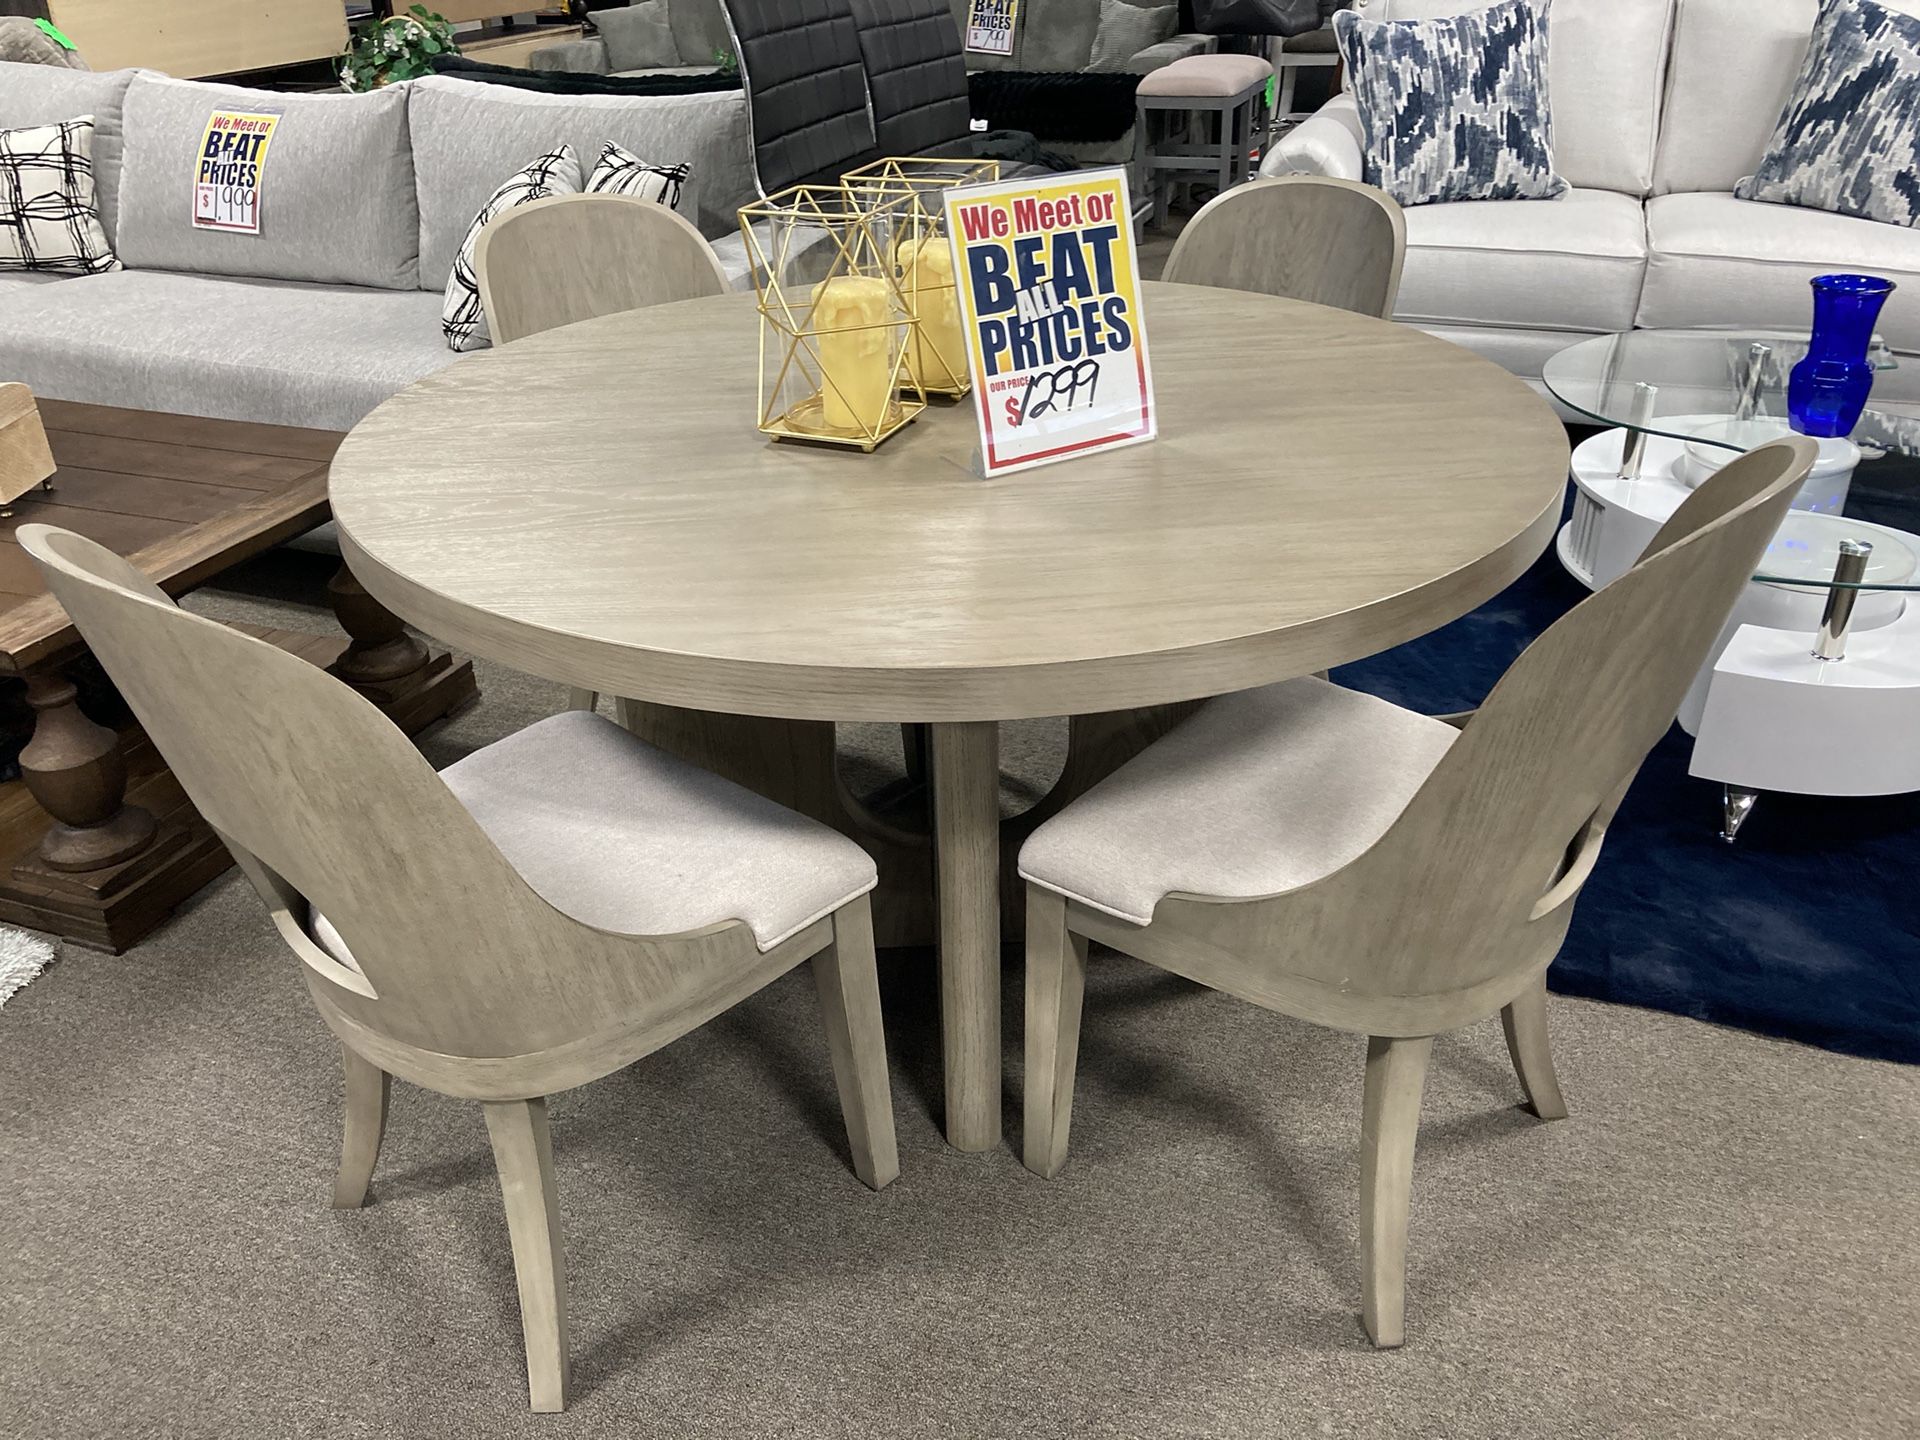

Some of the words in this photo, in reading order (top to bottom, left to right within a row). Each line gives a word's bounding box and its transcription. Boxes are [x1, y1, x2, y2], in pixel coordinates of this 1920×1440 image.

[972, 13, 1012, 30] PRICES
[213, 116, 230, 129] We
[231, 118, 258, 132] Meet
[258, 122, 271, 132] or
[203, 130, 266, 162] BEAT
[199, 160, 258, 188] PRICES
[959, 203, 1009, 241] We
[1013, 194, 1083, 234] Meet
[1088, 191, 1114, 222] or
[966, 225, 1119, 317] BEAT
[1015, 280, 1064, 325] ALL
[977, 297, 1132, 377] PRICES
[990, 379, 1007, 393] OUR
